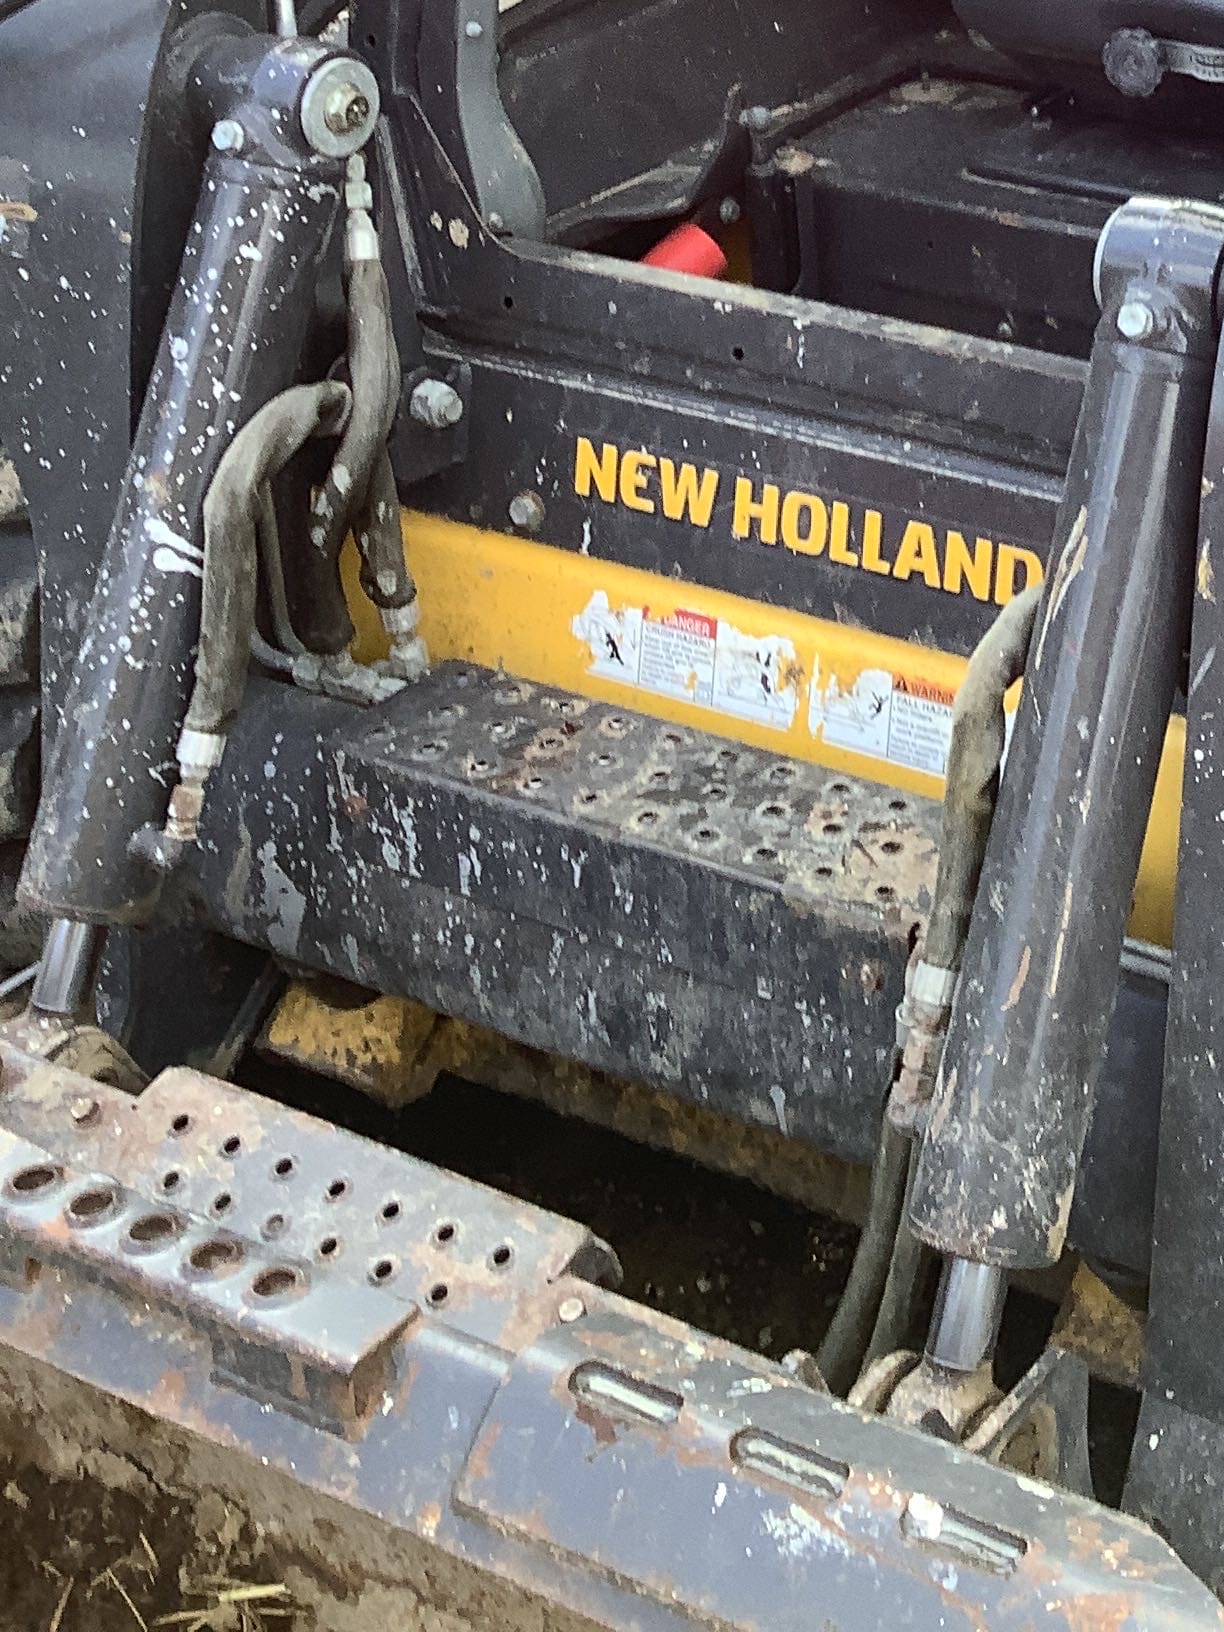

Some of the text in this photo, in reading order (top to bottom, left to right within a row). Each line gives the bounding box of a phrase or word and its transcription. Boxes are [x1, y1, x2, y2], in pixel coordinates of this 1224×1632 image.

[574, 436, 1045, 607] NEW HOLLAND
[911, 682, 955, 704] WARNIN
